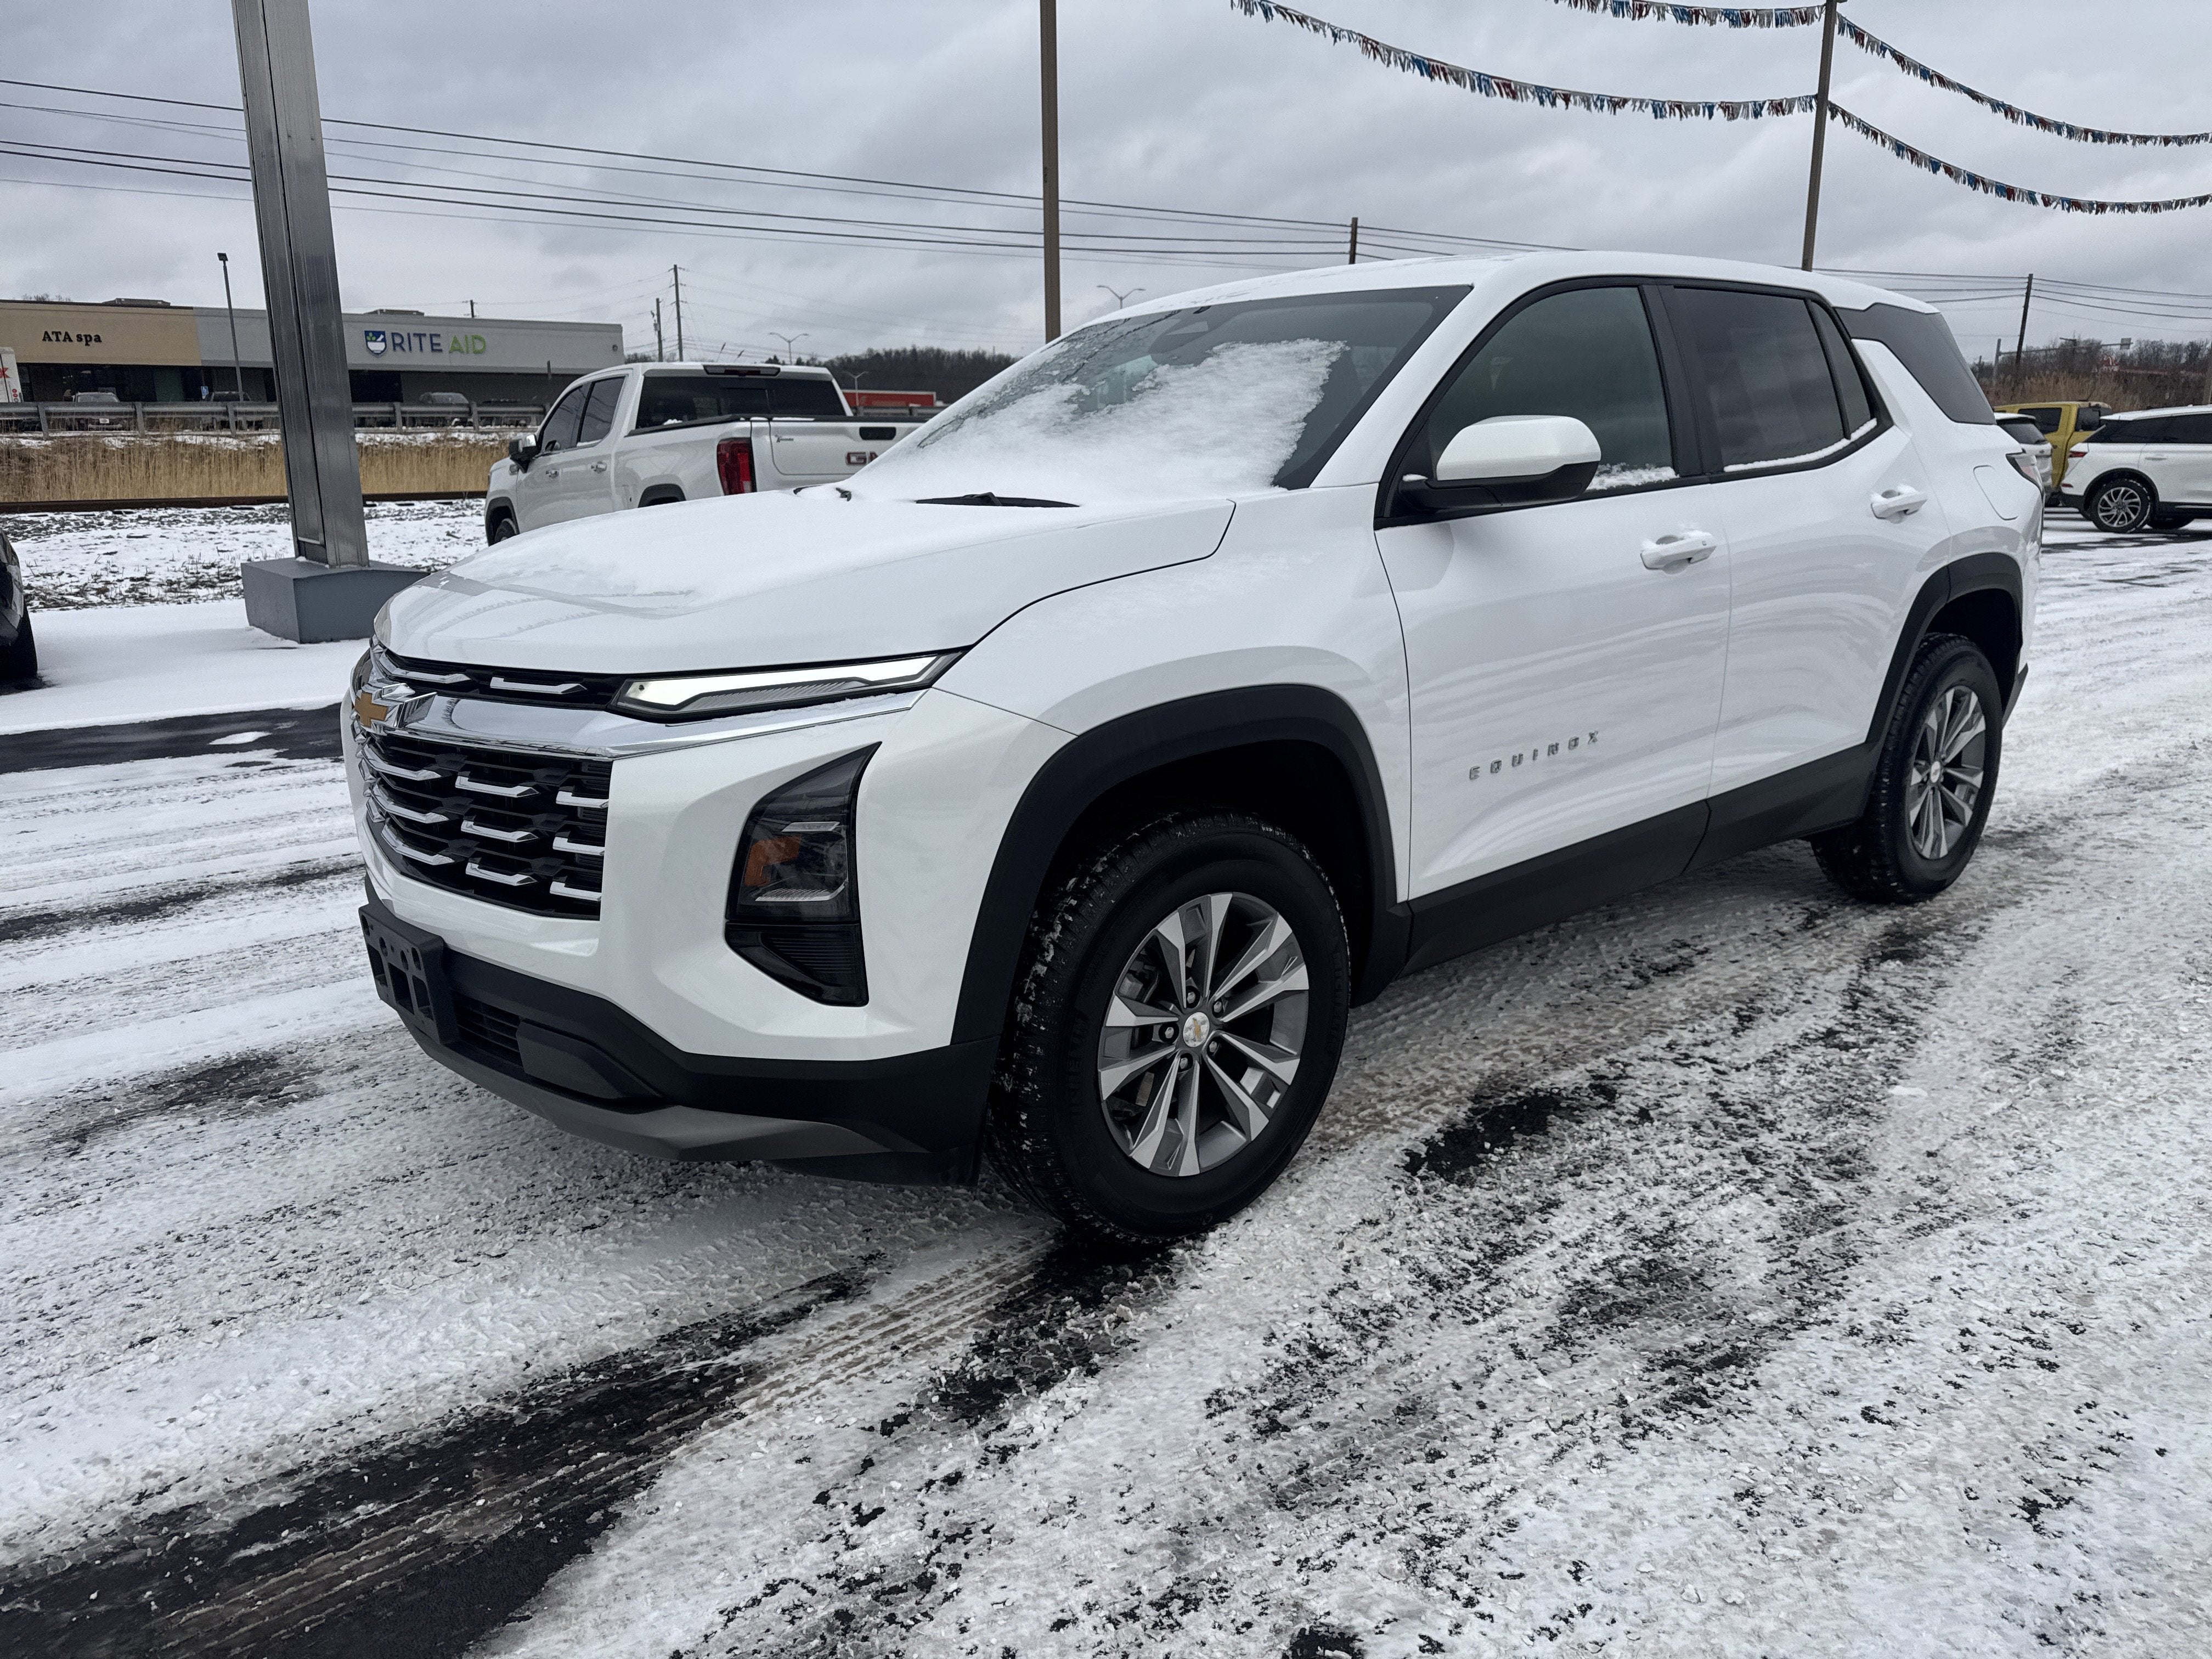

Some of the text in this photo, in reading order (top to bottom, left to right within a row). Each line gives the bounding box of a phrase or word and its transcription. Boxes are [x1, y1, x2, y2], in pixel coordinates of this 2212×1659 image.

[42, 331, 102, 346] ATA spa
[391, 332, 487, 354] RITE AID
[1469, 730, 1599, 780] EQUINOX
